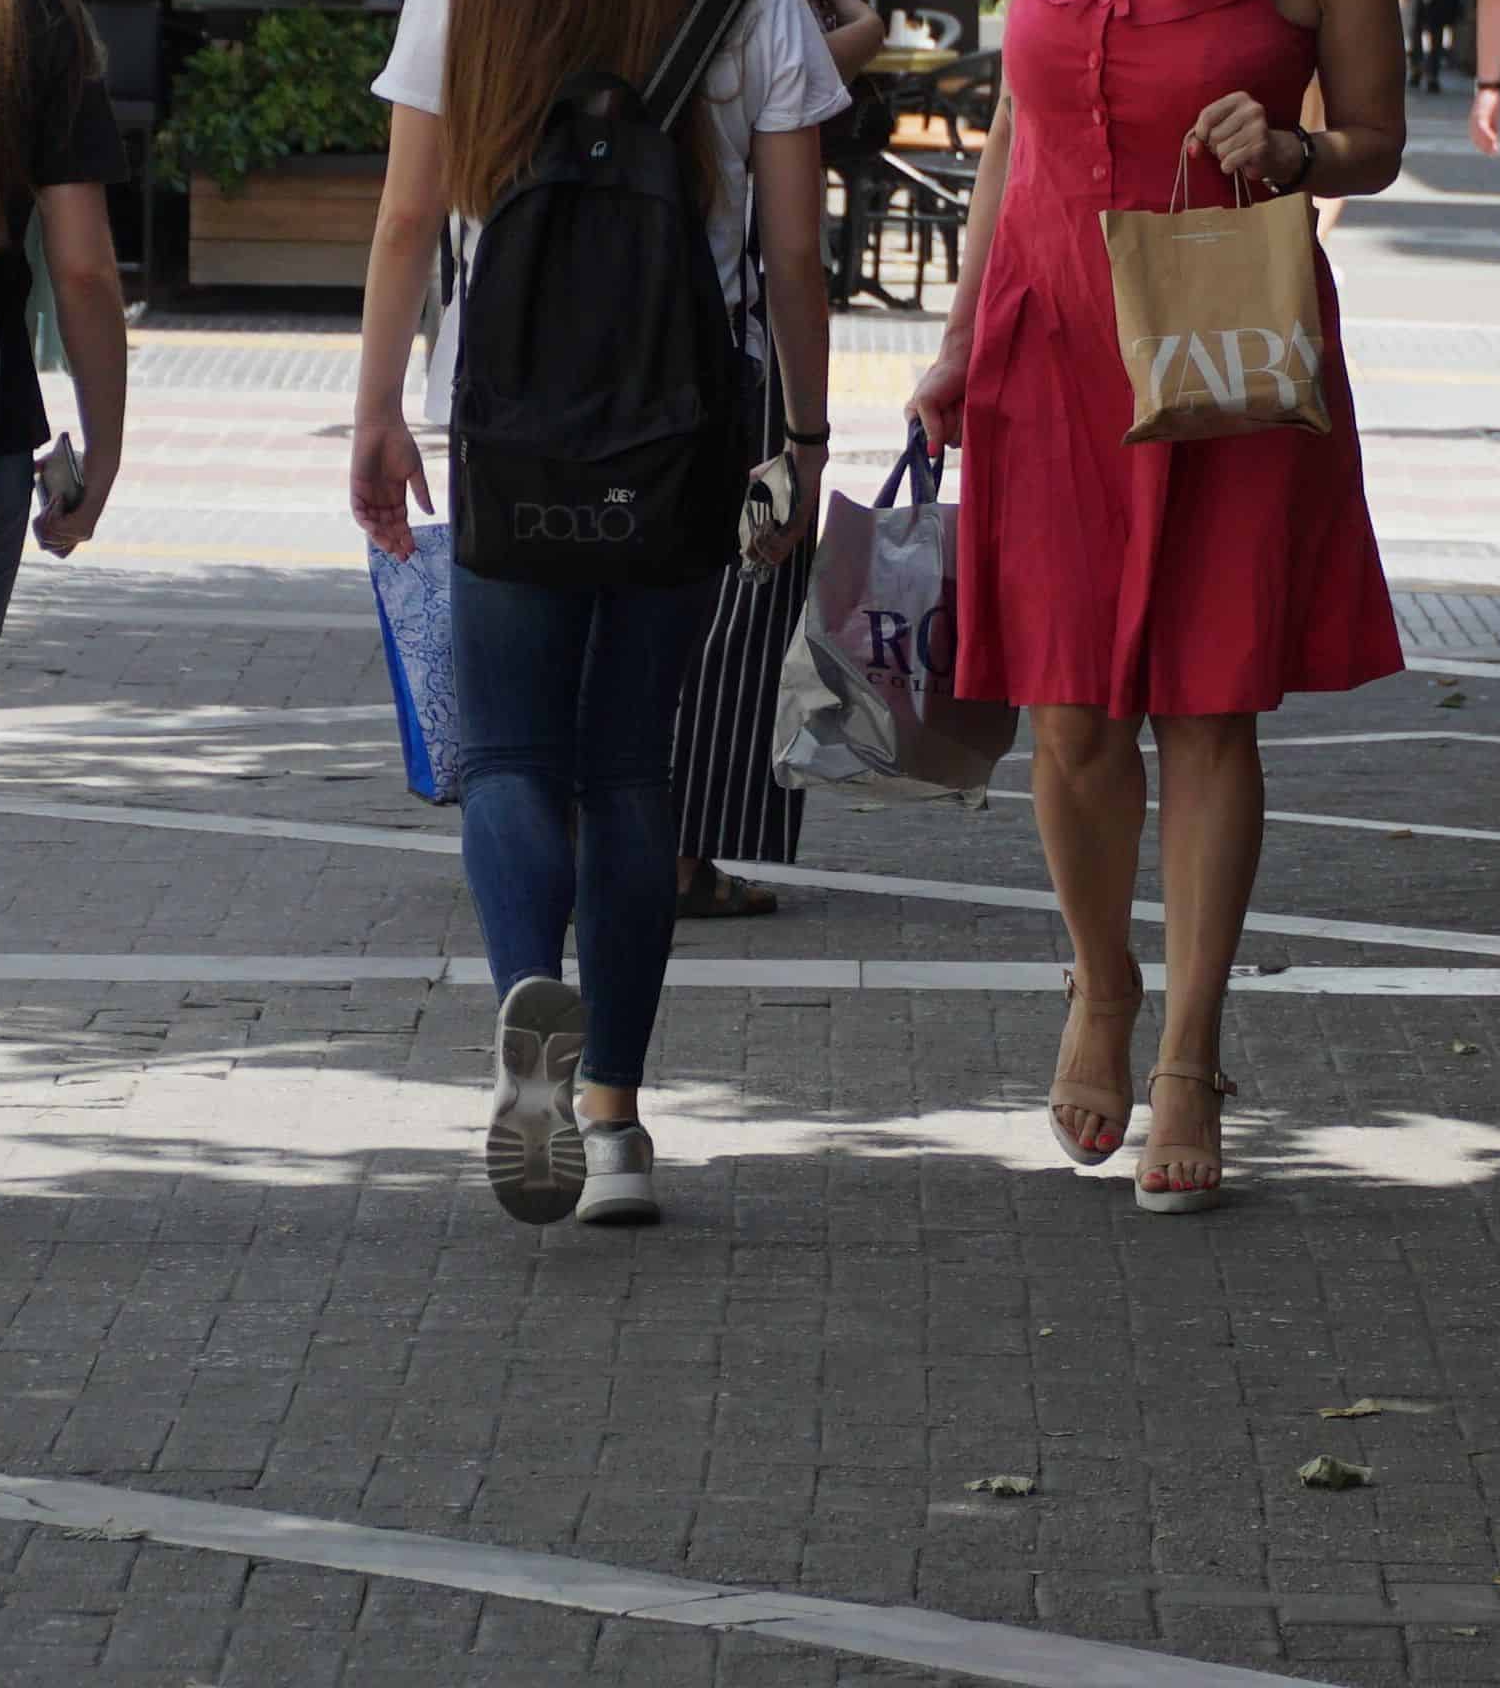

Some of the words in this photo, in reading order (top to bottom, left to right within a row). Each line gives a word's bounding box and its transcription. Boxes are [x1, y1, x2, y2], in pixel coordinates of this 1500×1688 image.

[1132, 320, 1328, 411] ZARA
[603, 487, 637, 503] JOEY
[514, 502, 636, 543] POLO
